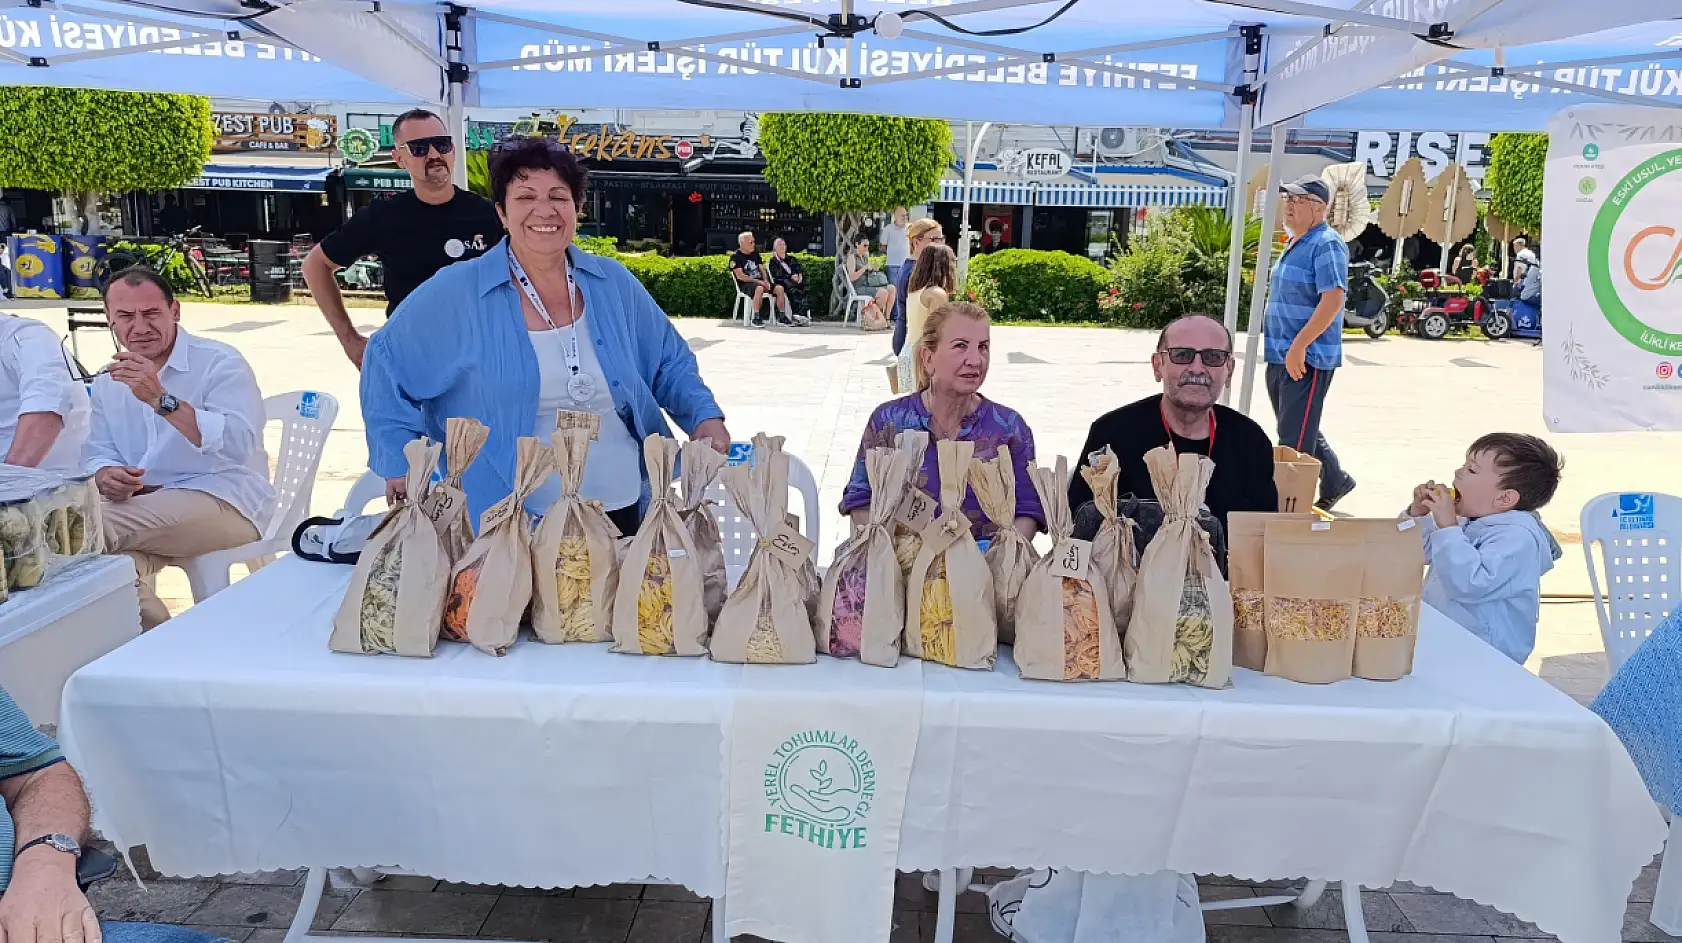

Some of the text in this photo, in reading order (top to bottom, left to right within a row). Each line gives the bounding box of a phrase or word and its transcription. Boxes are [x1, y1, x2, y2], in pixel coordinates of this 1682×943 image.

[212, 114, 294, 134] ZEST PUB
[1027, 153, 1063, 169] KEFAL
[1356, 131, 1490, 180] RISE
[212, 179, 232, 188] PUB
[232, 180, 274, 189] KITCHEN
[1612, 180, 1633, 206] ESKİ
[1632, 163, 1665, 184] USUL,
[764, 762, 781, 807] YEREL
[773, 729, 859, 758] TOHUMLAR
[764, 813, 868, 849] FETHİYE
